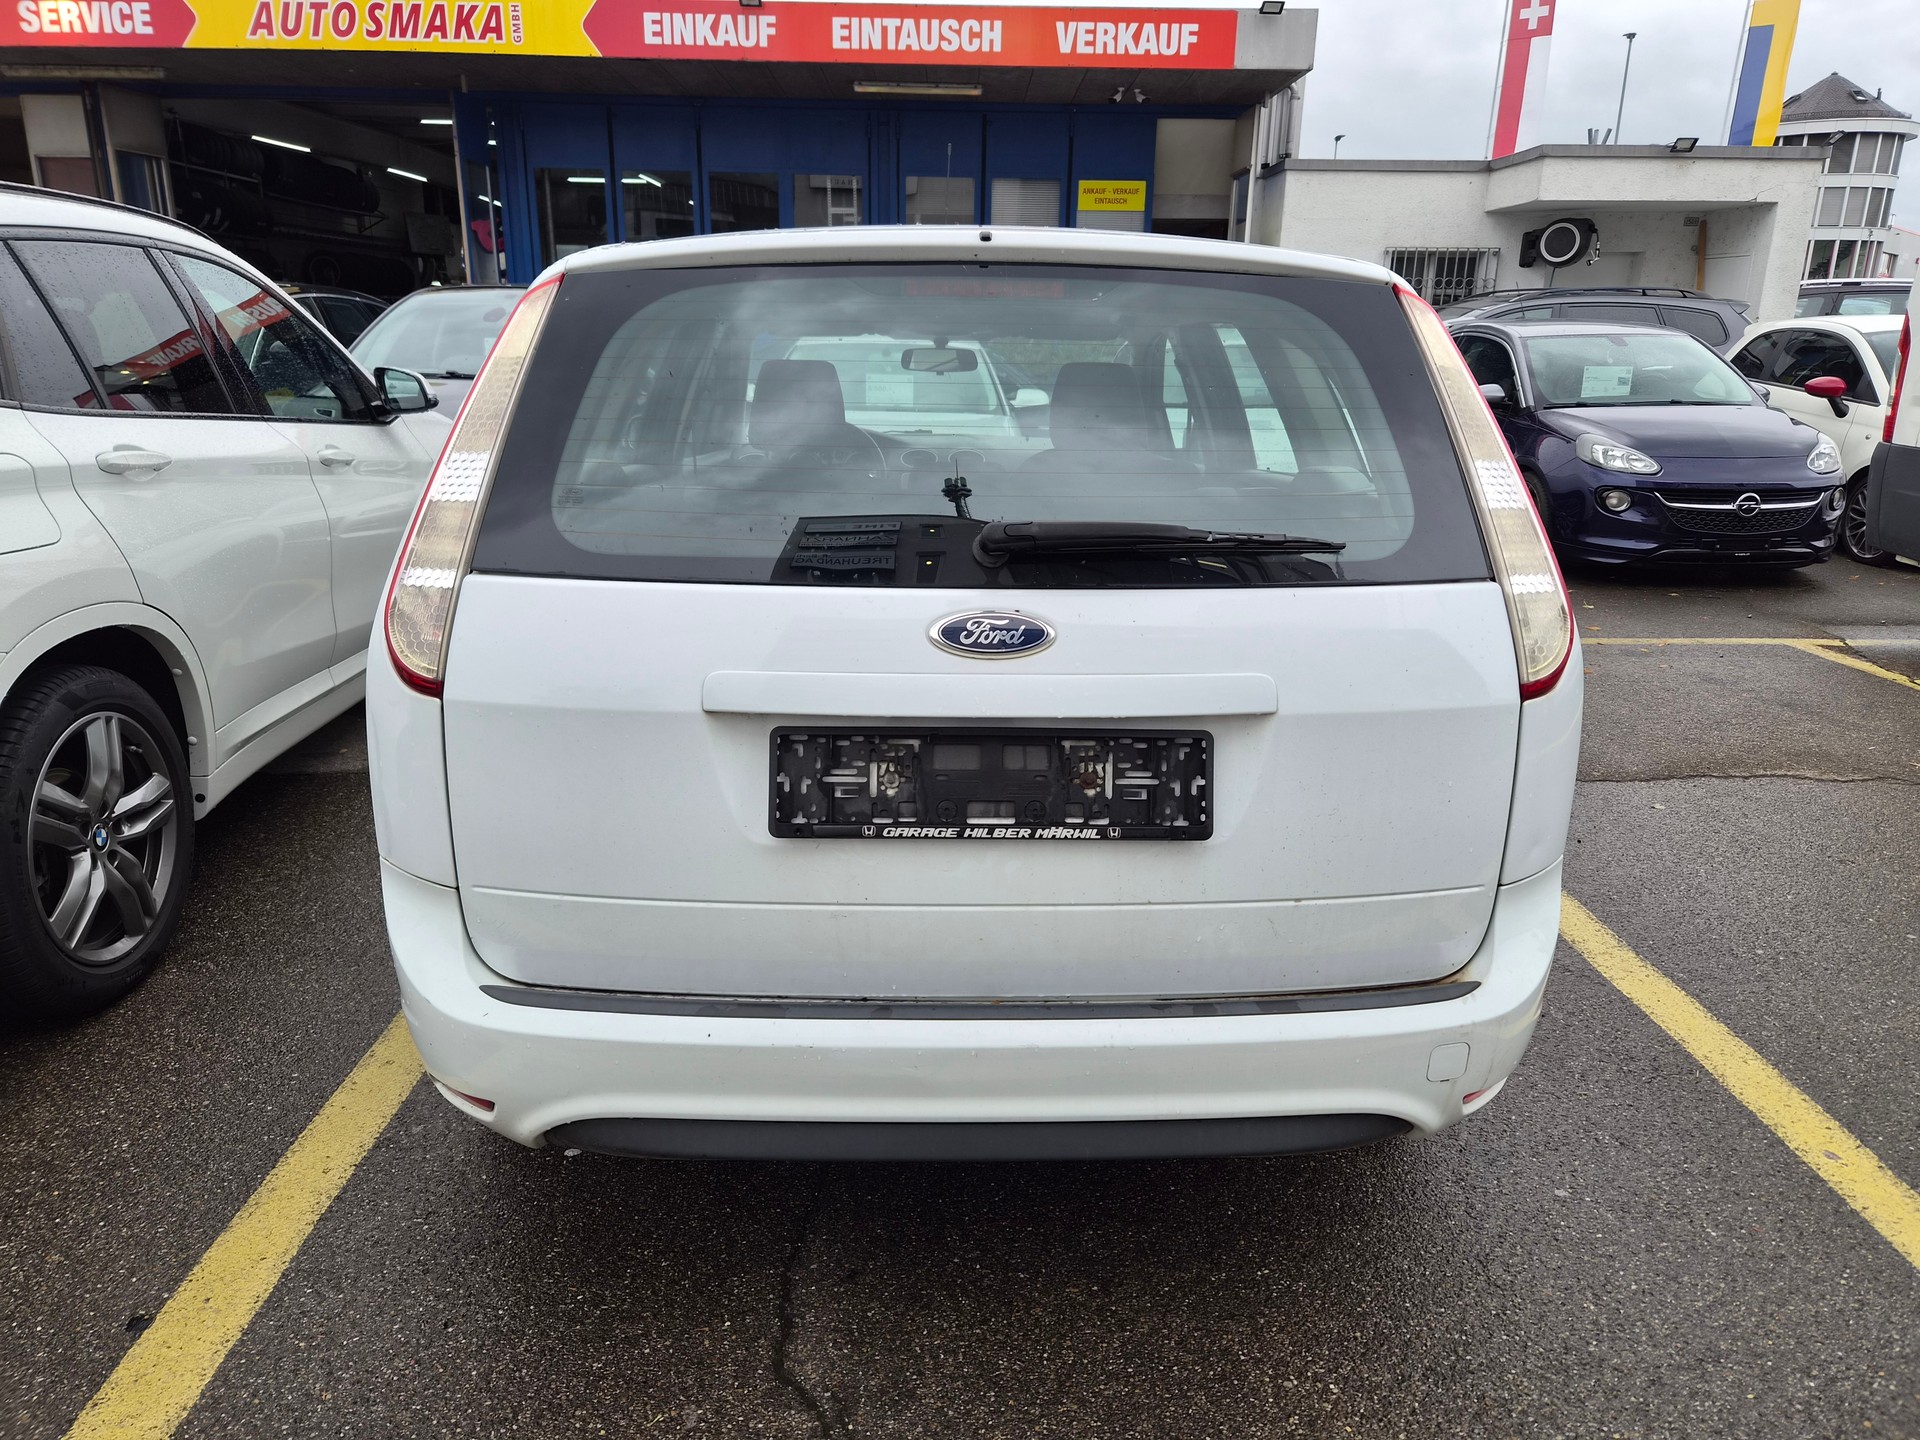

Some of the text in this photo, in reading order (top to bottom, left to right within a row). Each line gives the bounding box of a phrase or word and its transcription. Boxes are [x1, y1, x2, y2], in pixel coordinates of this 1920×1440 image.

[17, 1, 153, 34] SERVICE
[248, 1, 503, 41] AUTO SMAKA
[511, 4, 521, 43] GMBH
[643, 12, 776, 48] EINKAUF
[832, 17, 1002, 52] EINTAUSCH
[1056, 22, 1199, 56] VERKAUF
[960, 619, 1024, 644] Ford
[882, 827, 960, 838] GARAGE
[963, 828, 1031, 838] HILBER
